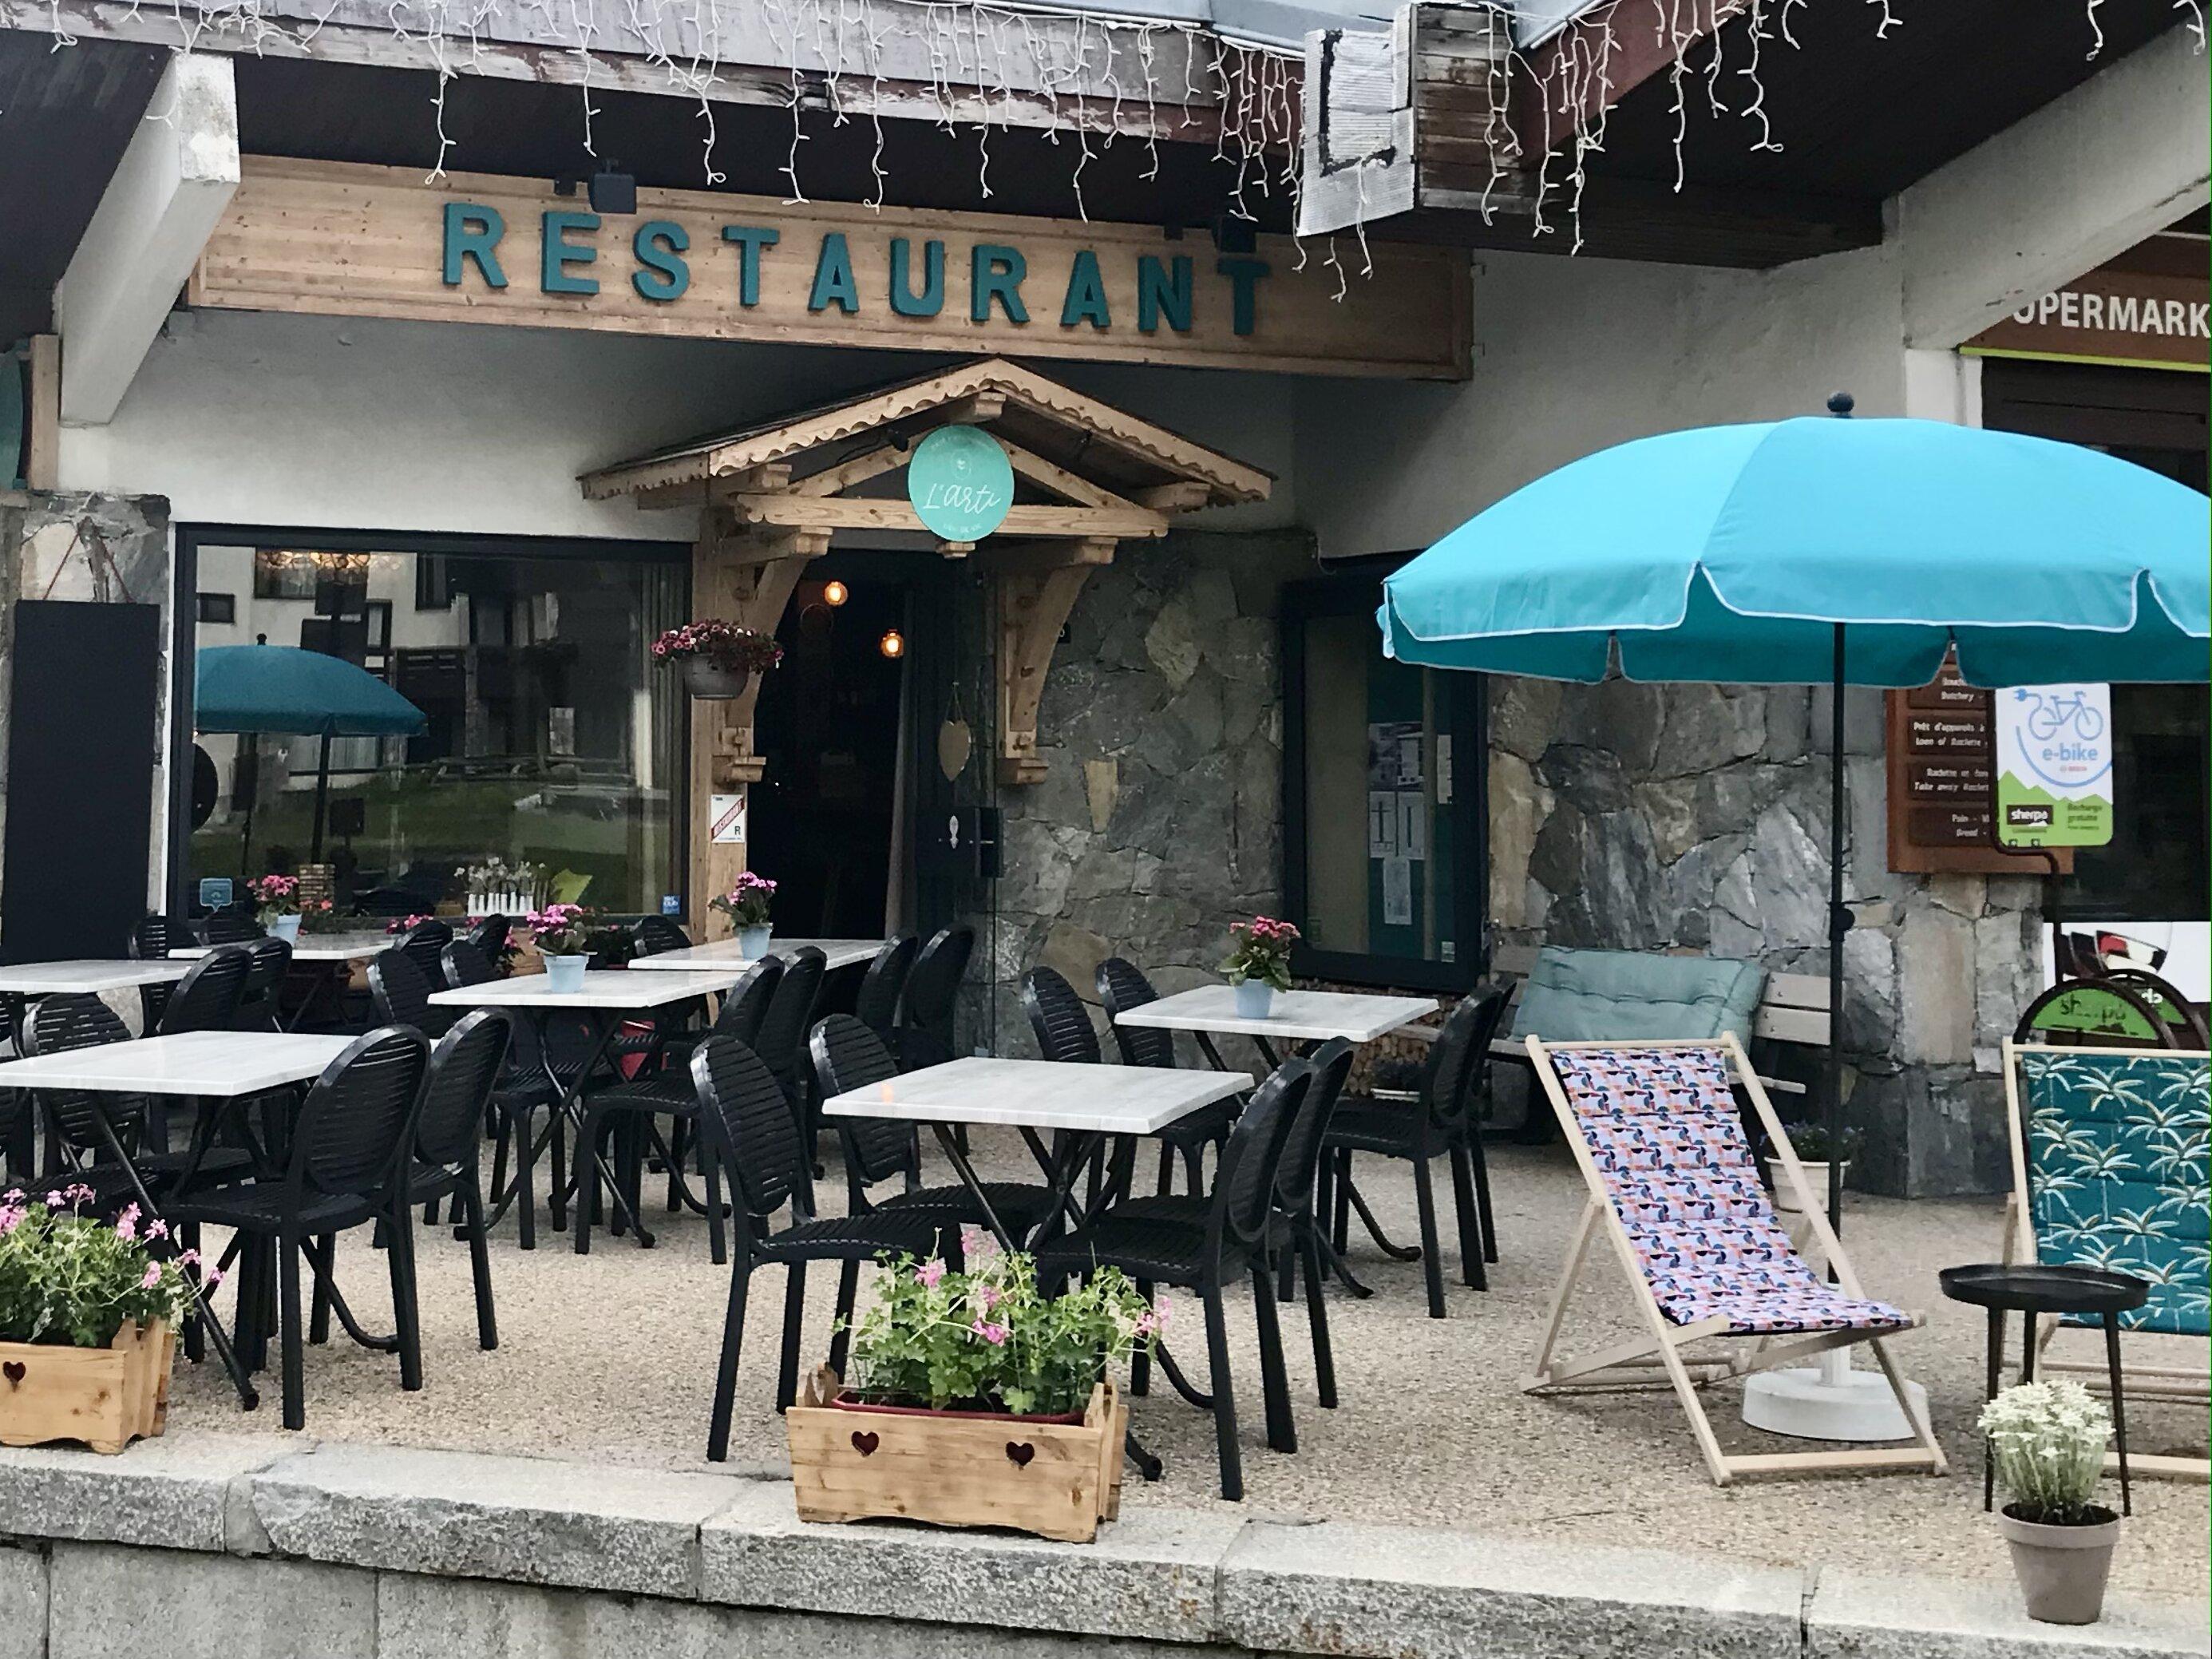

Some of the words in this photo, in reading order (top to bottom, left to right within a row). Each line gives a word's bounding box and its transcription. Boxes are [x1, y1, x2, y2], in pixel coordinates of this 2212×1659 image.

[442, 202, 1271, 336] RESTAURANT
[2042, 742, 2099, 761] e-bike
[2011, 808, 2049, 822] sherpa
[734, 826, 741, 835] R
